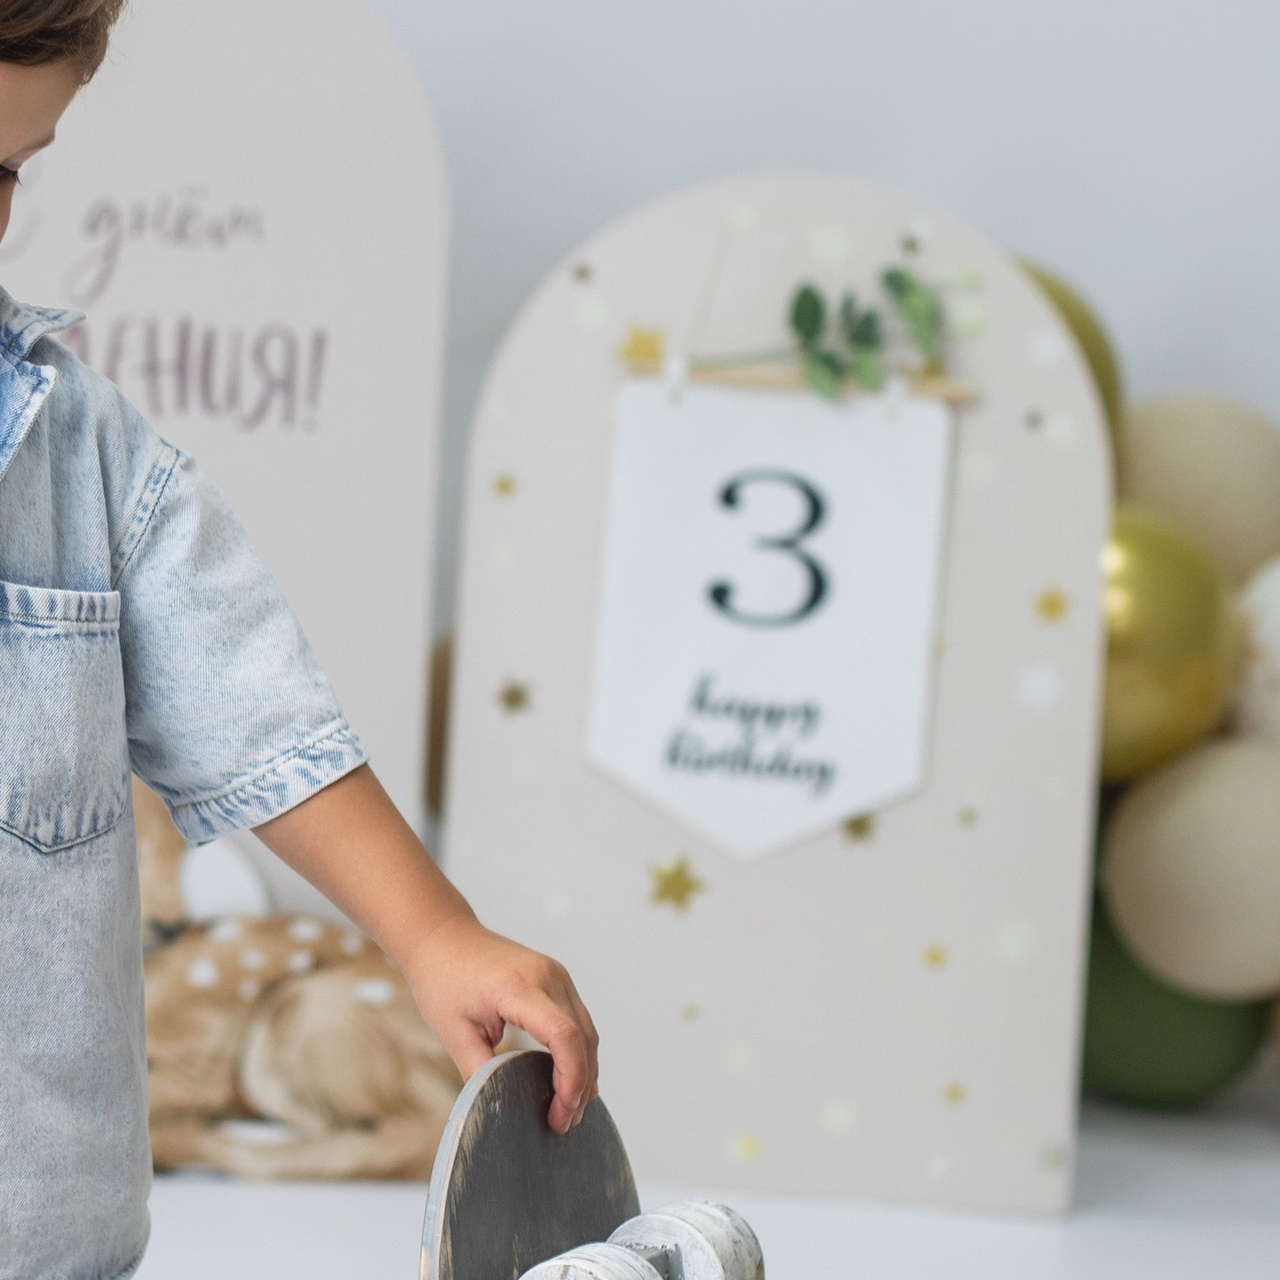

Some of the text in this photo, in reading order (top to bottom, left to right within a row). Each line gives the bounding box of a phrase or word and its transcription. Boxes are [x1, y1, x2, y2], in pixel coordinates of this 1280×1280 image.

[707, 468, 829, 629] 3
[689, 672, 821, 737] happy
[662, 729, 838, 798] birthday
